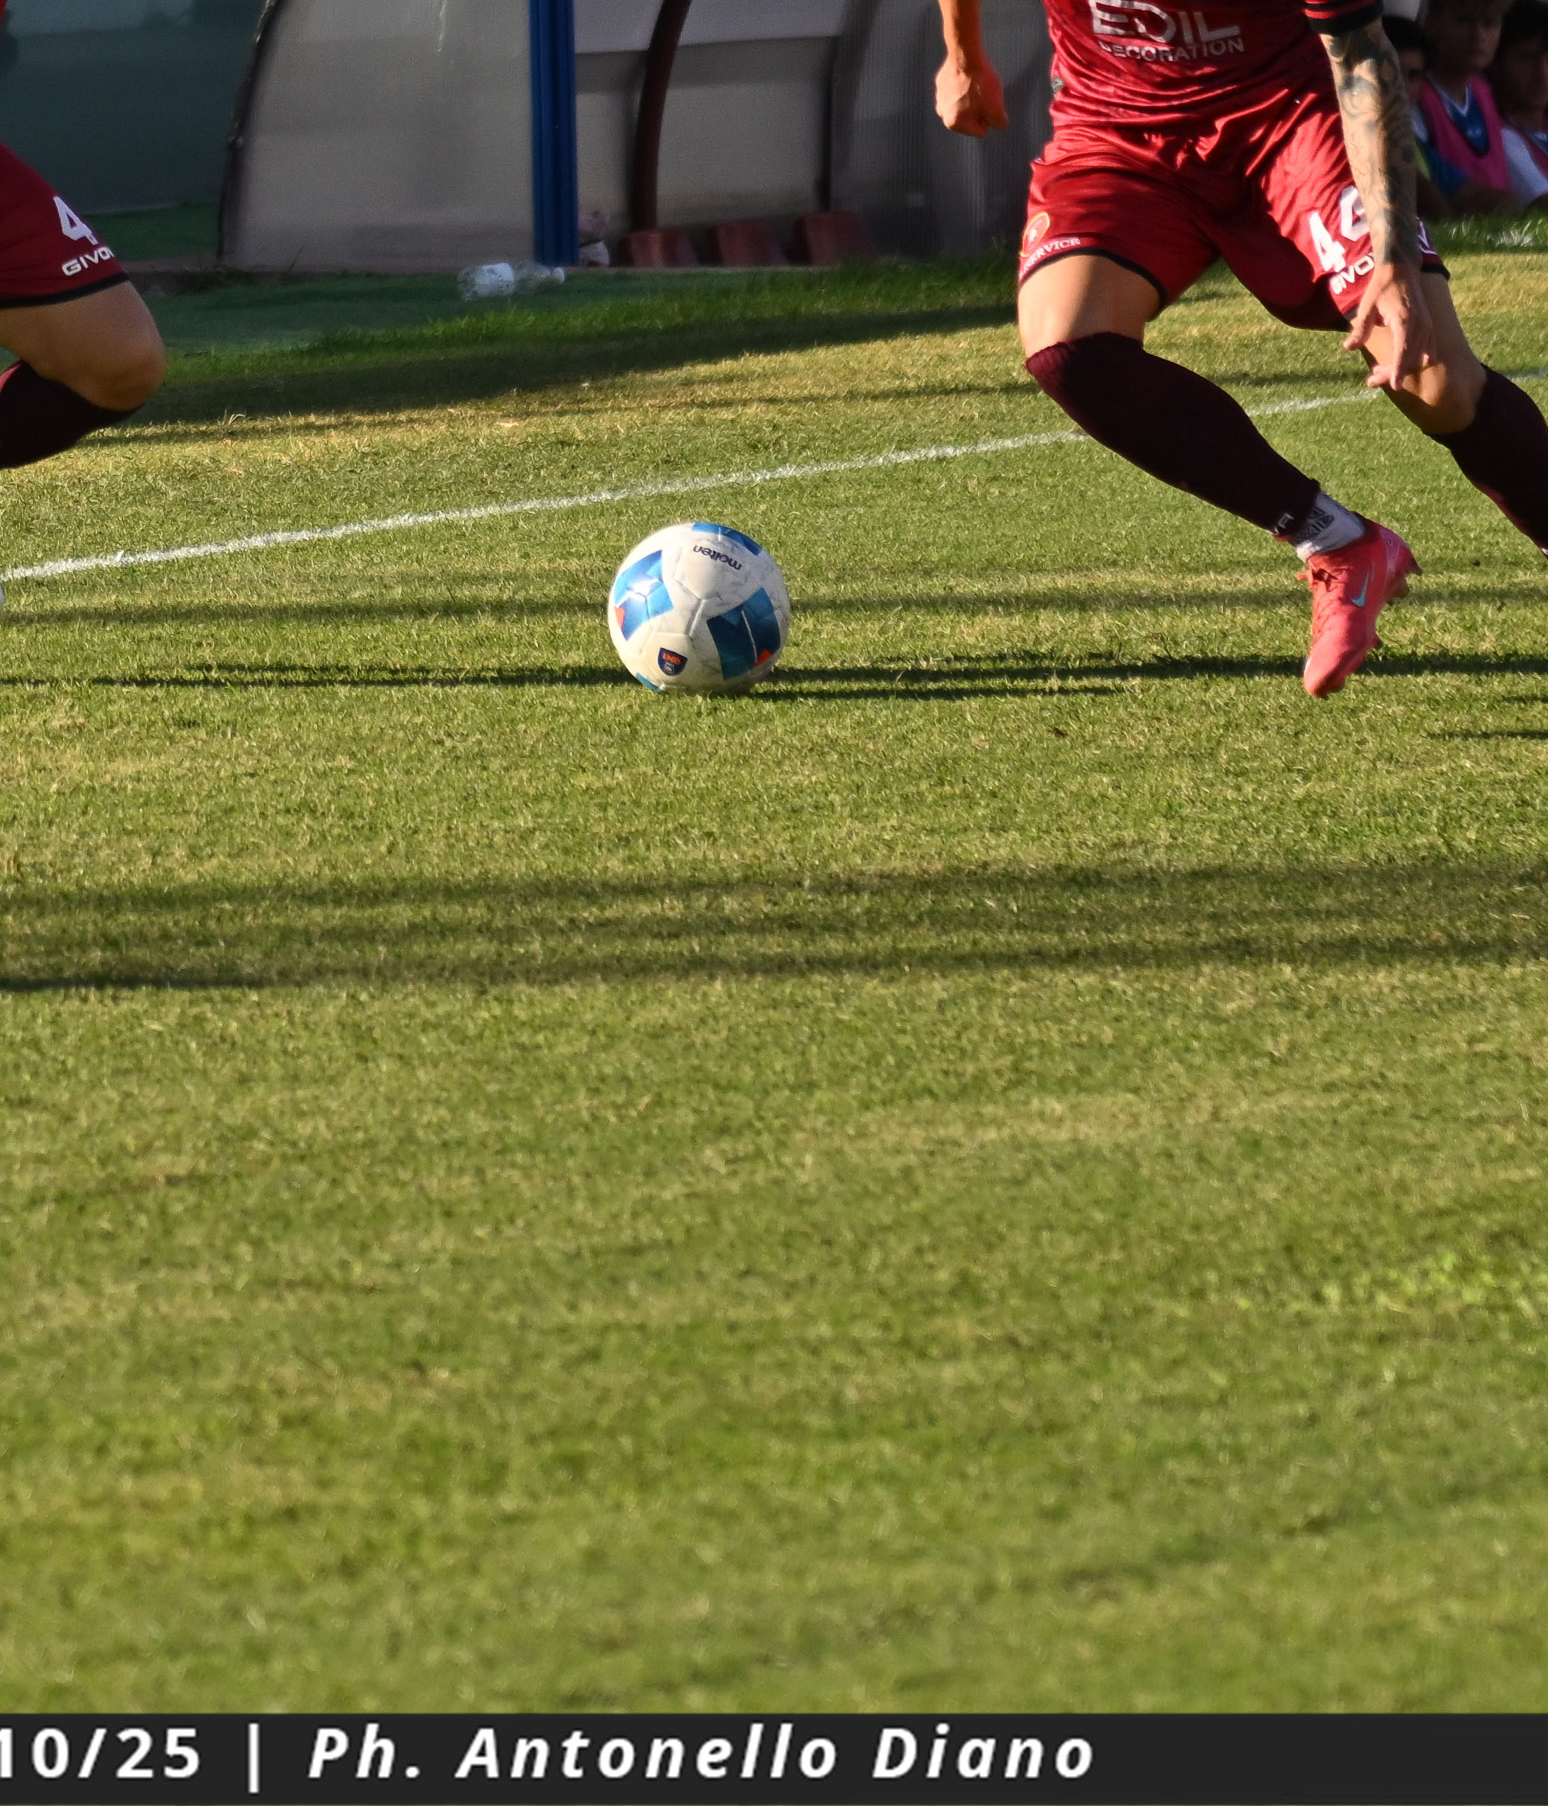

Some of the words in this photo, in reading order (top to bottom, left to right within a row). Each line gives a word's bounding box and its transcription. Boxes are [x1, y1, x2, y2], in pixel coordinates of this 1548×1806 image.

[1098, 38, 1245, 62] DECORATION
[1330, 252, 1375, 294] GIVO
[693, 545, 742, 571] molten
